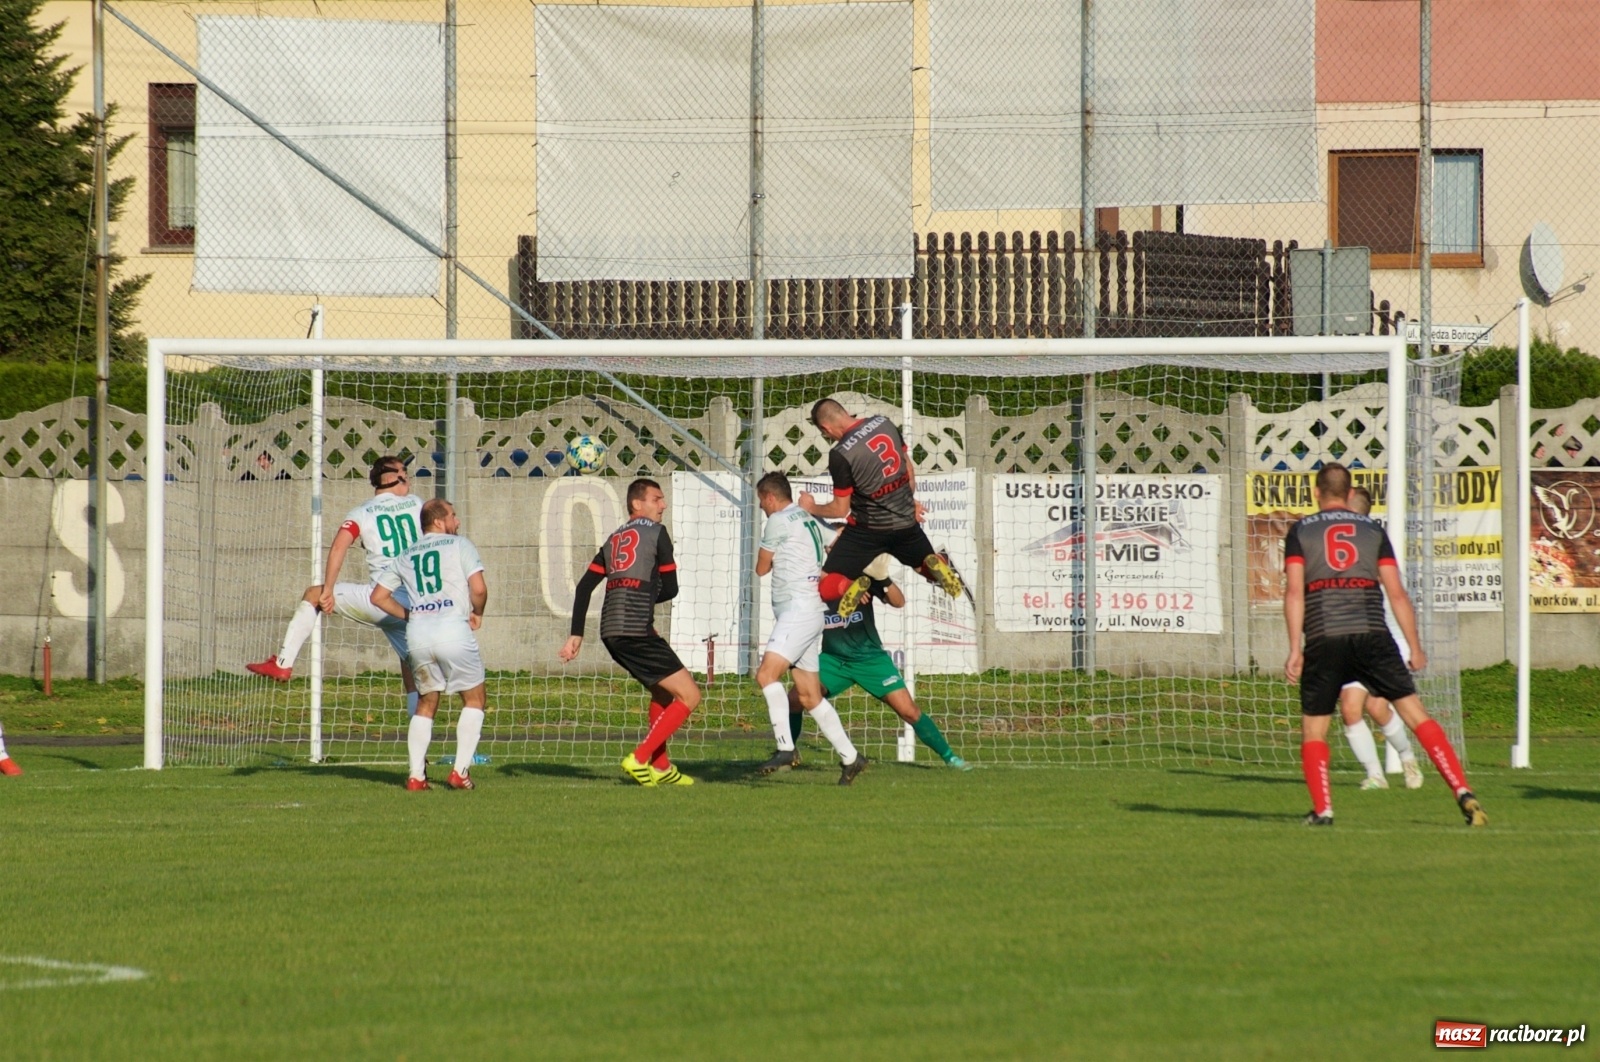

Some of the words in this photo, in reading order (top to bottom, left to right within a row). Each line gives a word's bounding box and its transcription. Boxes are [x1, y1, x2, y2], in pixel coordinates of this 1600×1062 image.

[1407, 328, 1418, 339] ul.
[842, 436, 858, 451] LKS
[854, 416, 887, 439] TWORKÓ
[865, 433, 901, 478] 3
[805, 482, 835, 495] Usług
[915, 479, 966, 493] udowlane
[1006, 483, 1084, 498] USŁUGI
[1094, 483, 1211, 499] DEKARSKO-
[1253, 474, 1313, 507] OKNA
[1407, 470, 1500, 506] SHODY
[1048, 506, 1168, 521] CIESIELSKIE
[928, 518, 968, 533] wnętrz
[376, 513, 418, 558] 90
[52, 479, 125, 621] S
[610, 528, 640, 574] 13
[1323, 523, 1359, 571] 6
[411, 551, 443, 597] 19
[1052, 568, 1101, 582] Grzegz
[1469, 575, 1484, 587] 62
[1487, 575, 1502, 586] 99
[1023, 592, 1056, 609] tel.
[1111, 593, 1148, 609] 196
[1156, 593, 1194, 610] 012
[1490, 590, 1503, 602] 41
[1033, 614, 1103, 628] Tworkó,
[1108, 615, 1125, 627] ul.
[1131, 615, 1171, 627] Nowa
[1176, 615, 1185, 627] 8
